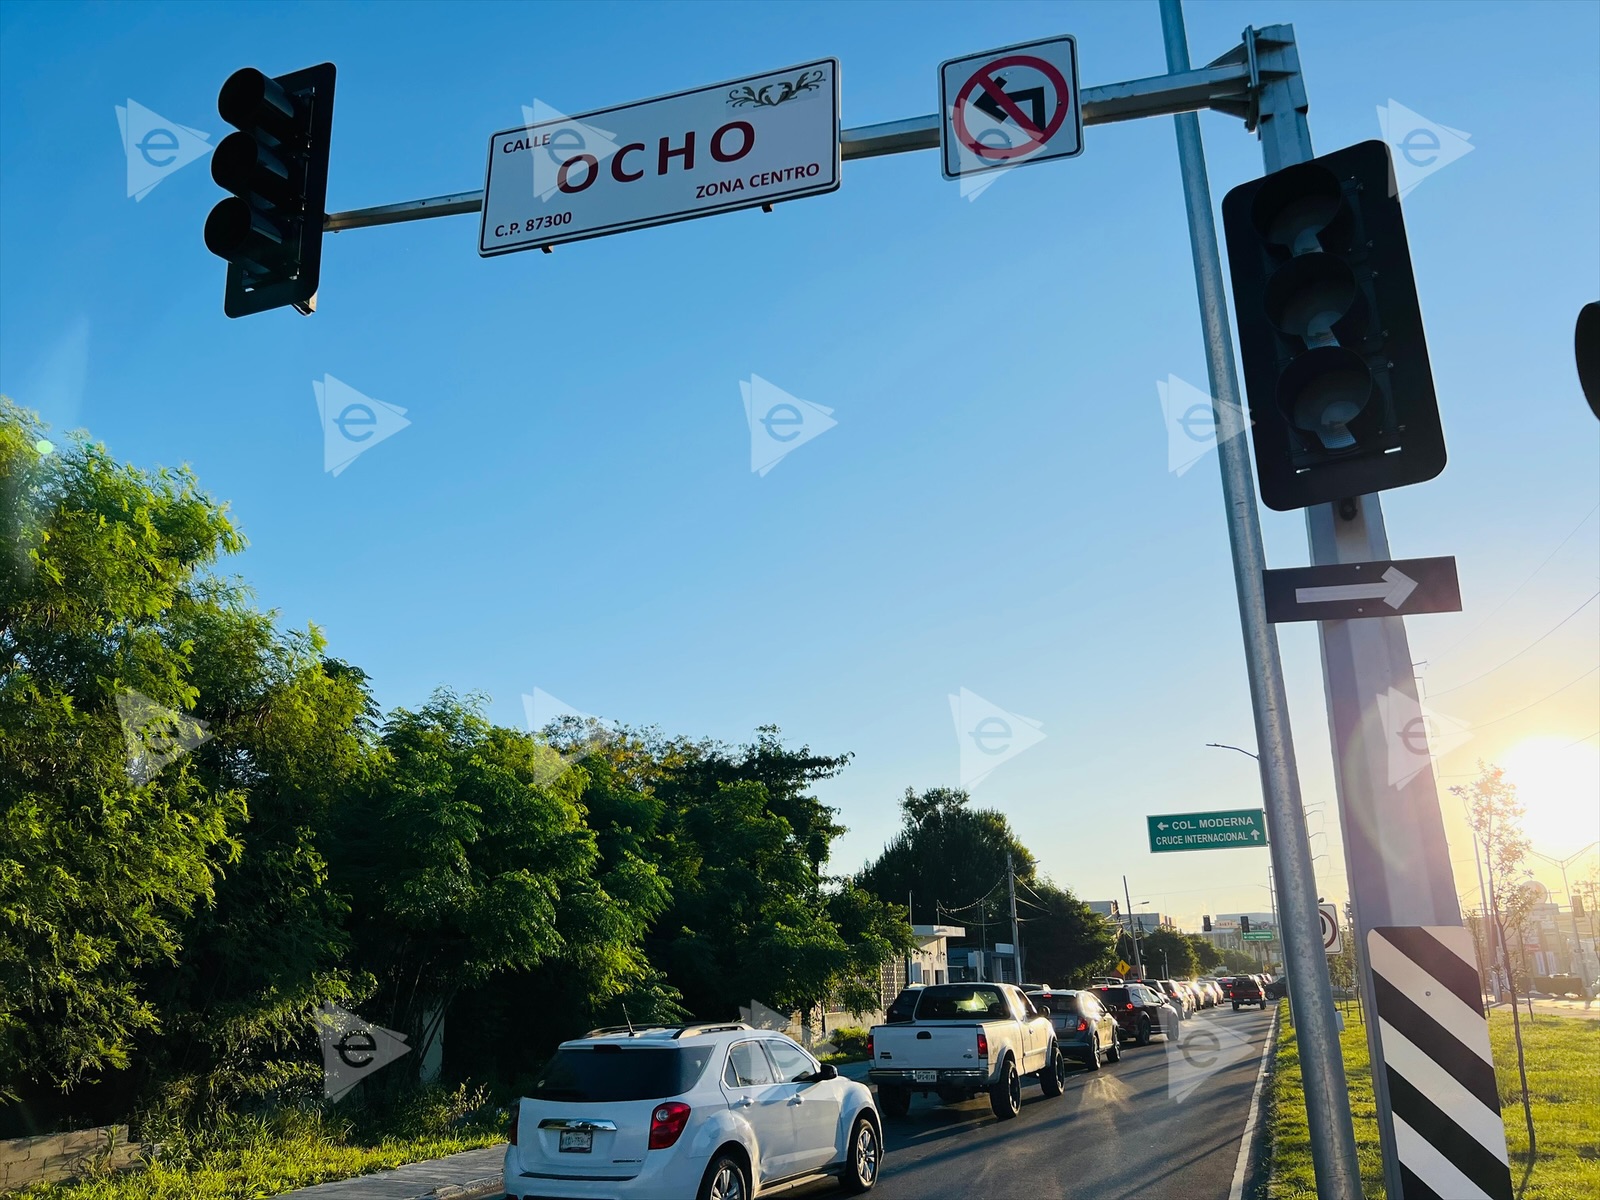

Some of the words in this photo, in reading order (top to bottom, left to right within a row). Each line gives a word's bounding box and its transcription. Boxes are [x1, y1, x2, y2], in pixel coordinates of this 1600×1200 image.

[503, 133, 551, 154] CALLE
[557, 121, 755, 194] OCHO
[696, 178, 744, 199] ZONA
[750, 162, 820, 188] CENTRO
[494, 223, 521, 238] C.P.
[525, 211, 572, 233] 87300
[1172, 821, 1197, 830] COL.
[1199, 816, 1255, 829] MODERNA
[1156, 835, 1183, 846] CRUCE
[1185, 831, 1249, 844] INTERNACIONAL
